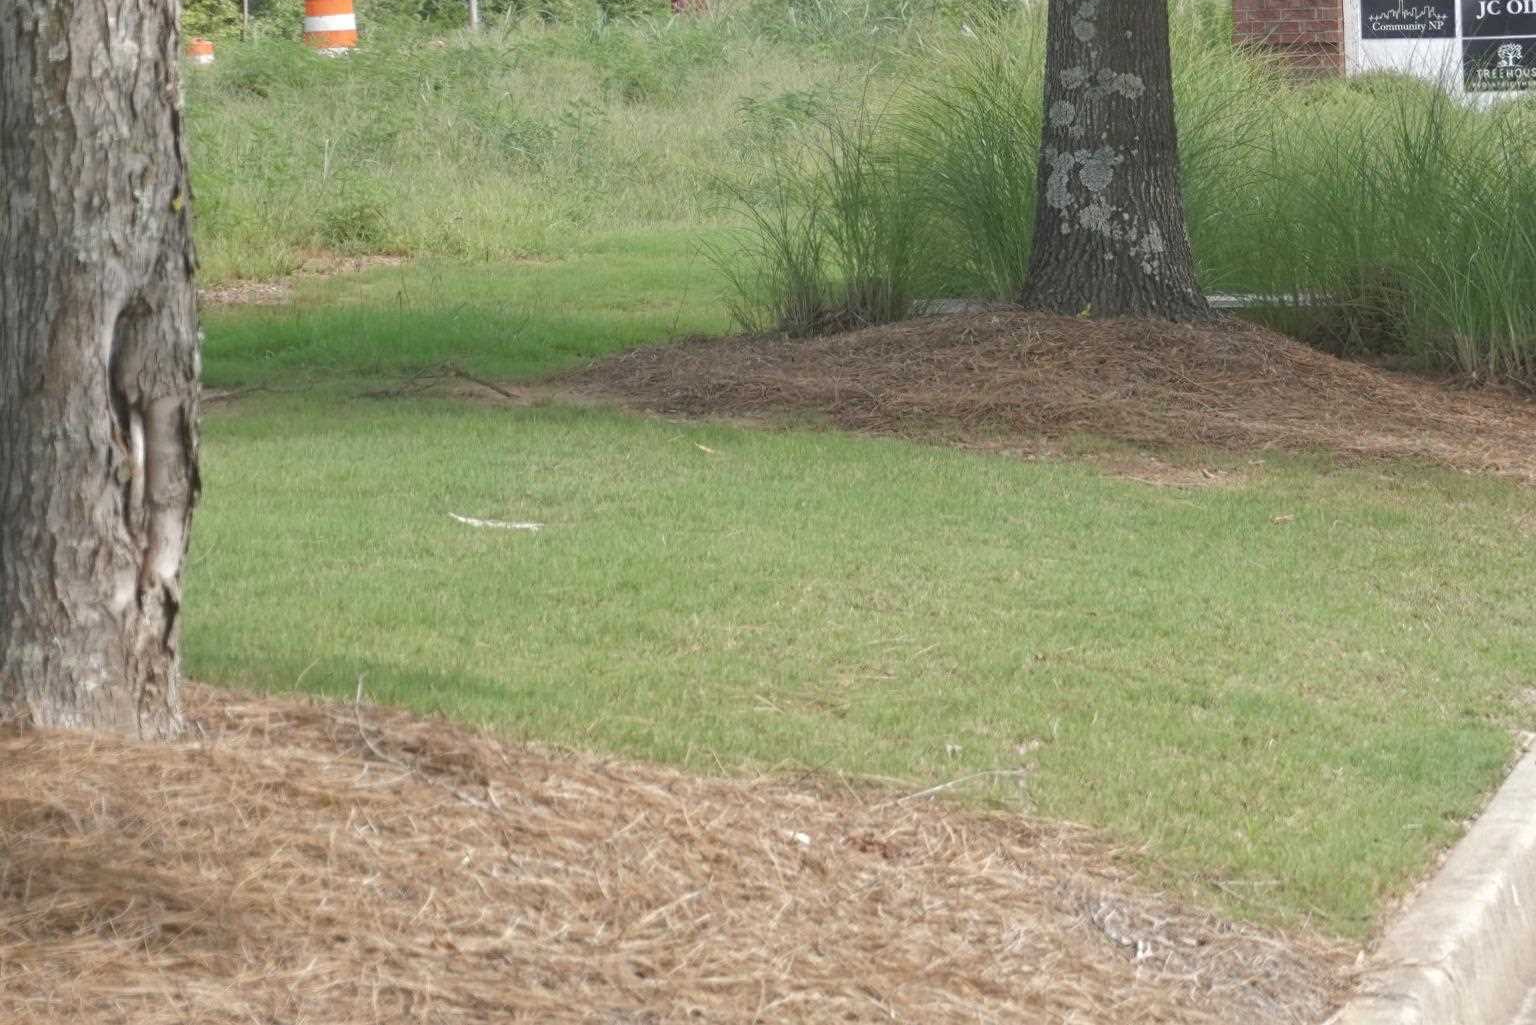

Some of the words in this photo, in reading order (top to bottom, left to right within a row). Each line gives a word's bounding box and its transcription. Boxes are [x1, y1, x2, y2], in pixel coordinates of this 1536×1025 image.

[1476, 0, 1501, 19] JC
[1372, 22, 1426, 33] Community
[1428, 21, 1444, 30] NP
